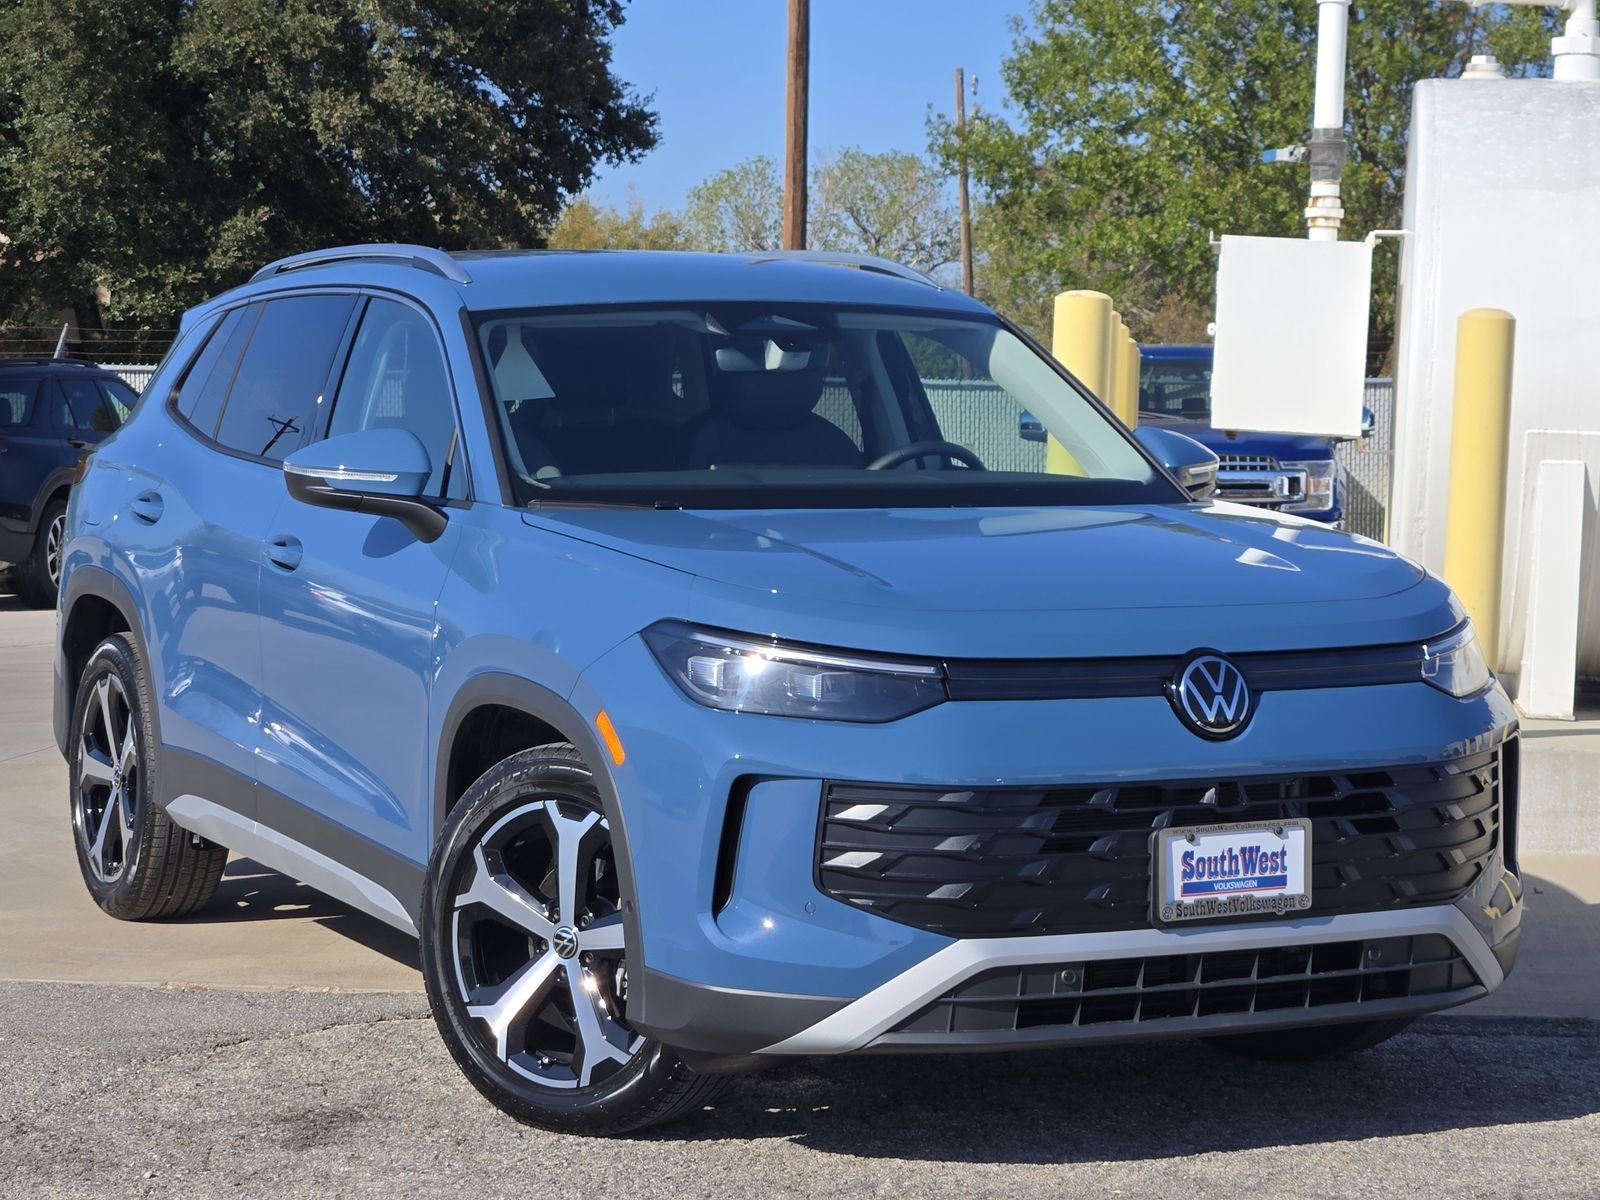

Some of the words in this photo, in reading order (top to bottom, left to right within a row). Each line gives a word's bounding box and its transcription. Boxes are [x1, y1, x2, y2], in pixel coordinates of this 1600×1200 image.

[1181, 656, 1248, 732] VW
[1172, 820, 1299, 834] www.SouthWestVolkswagen.com
[1213, 880, 1258, 891] VOLKSWAGEN
[1176, 896, 1296, 918] SouthWestVolkswagen
